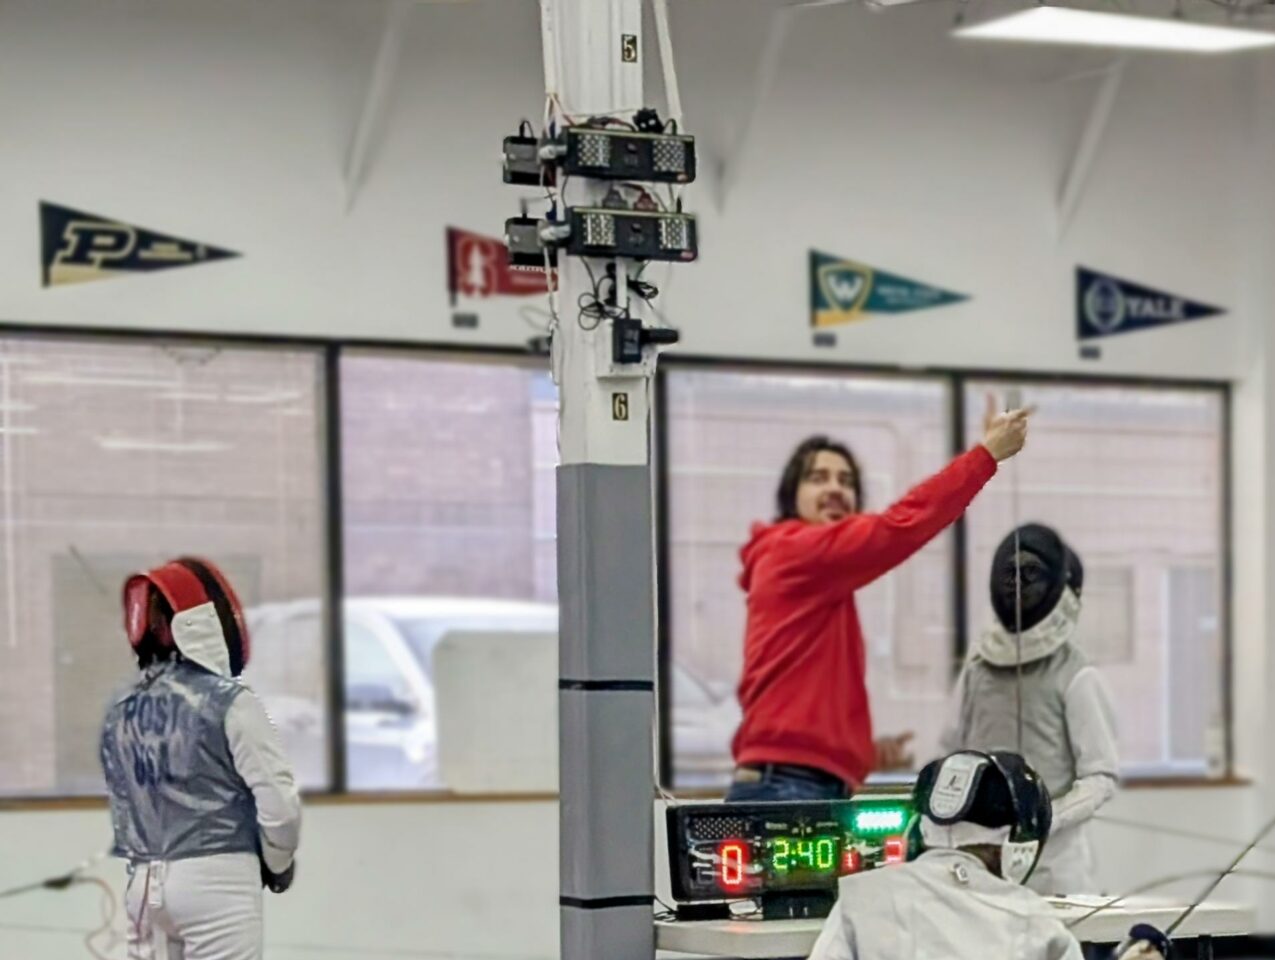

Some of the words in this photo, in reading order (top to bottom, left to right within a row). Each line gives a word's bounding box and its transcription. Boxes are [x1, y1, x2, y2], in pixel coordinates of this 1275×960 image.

[623, 35, 636, 61] 5
[54, 221, 137, 270] P
[827, 274, 864, 302] W
[1122, 297, 1185, 318] YALE
[615, 394, 626, 419] 6
[722, 845, 742, 884] 0
[773, 839, 833, 869] 2:40
